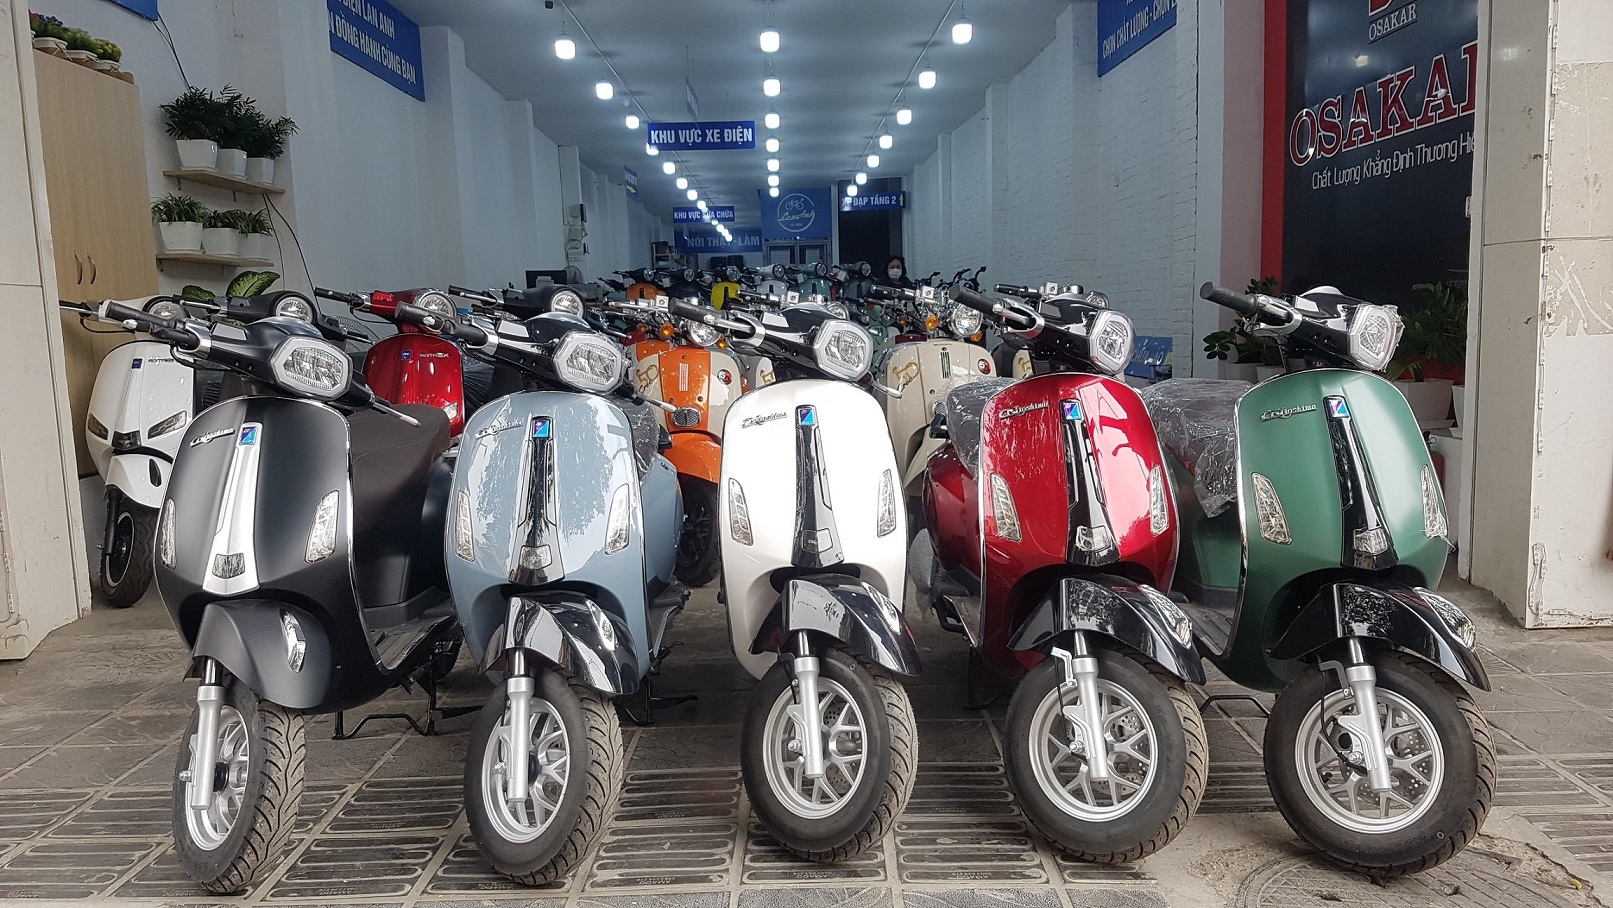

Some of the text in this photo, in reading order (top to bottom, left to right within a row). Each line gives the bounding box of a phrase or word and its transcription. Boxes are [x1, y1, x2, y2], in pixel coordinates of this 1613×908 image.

[379, 11, 395, 39] ANH
[1369, 3, 1417, 41] OSAKAR
[359, 30, 382, 63] HÀNH
[381, 44, 402, 76] CÙNG
[401, 59, 416, 84] BẠN
[651, 125, 753, 146] KHU VỰC XE ĐIỆN
[1312, 166, 1332, 190] Chất
[1363, 149, 1392, 179] Khẳng
[1393, 147, 1414, 173] Định
[853, 197, 868, 208] ĐẠP
[891, 195, 897, 205] 2
[674, 211, 687, 219] KHU
[688, 210, 701, 220] VỰC
[738, 233, 760, 246] LÀM
